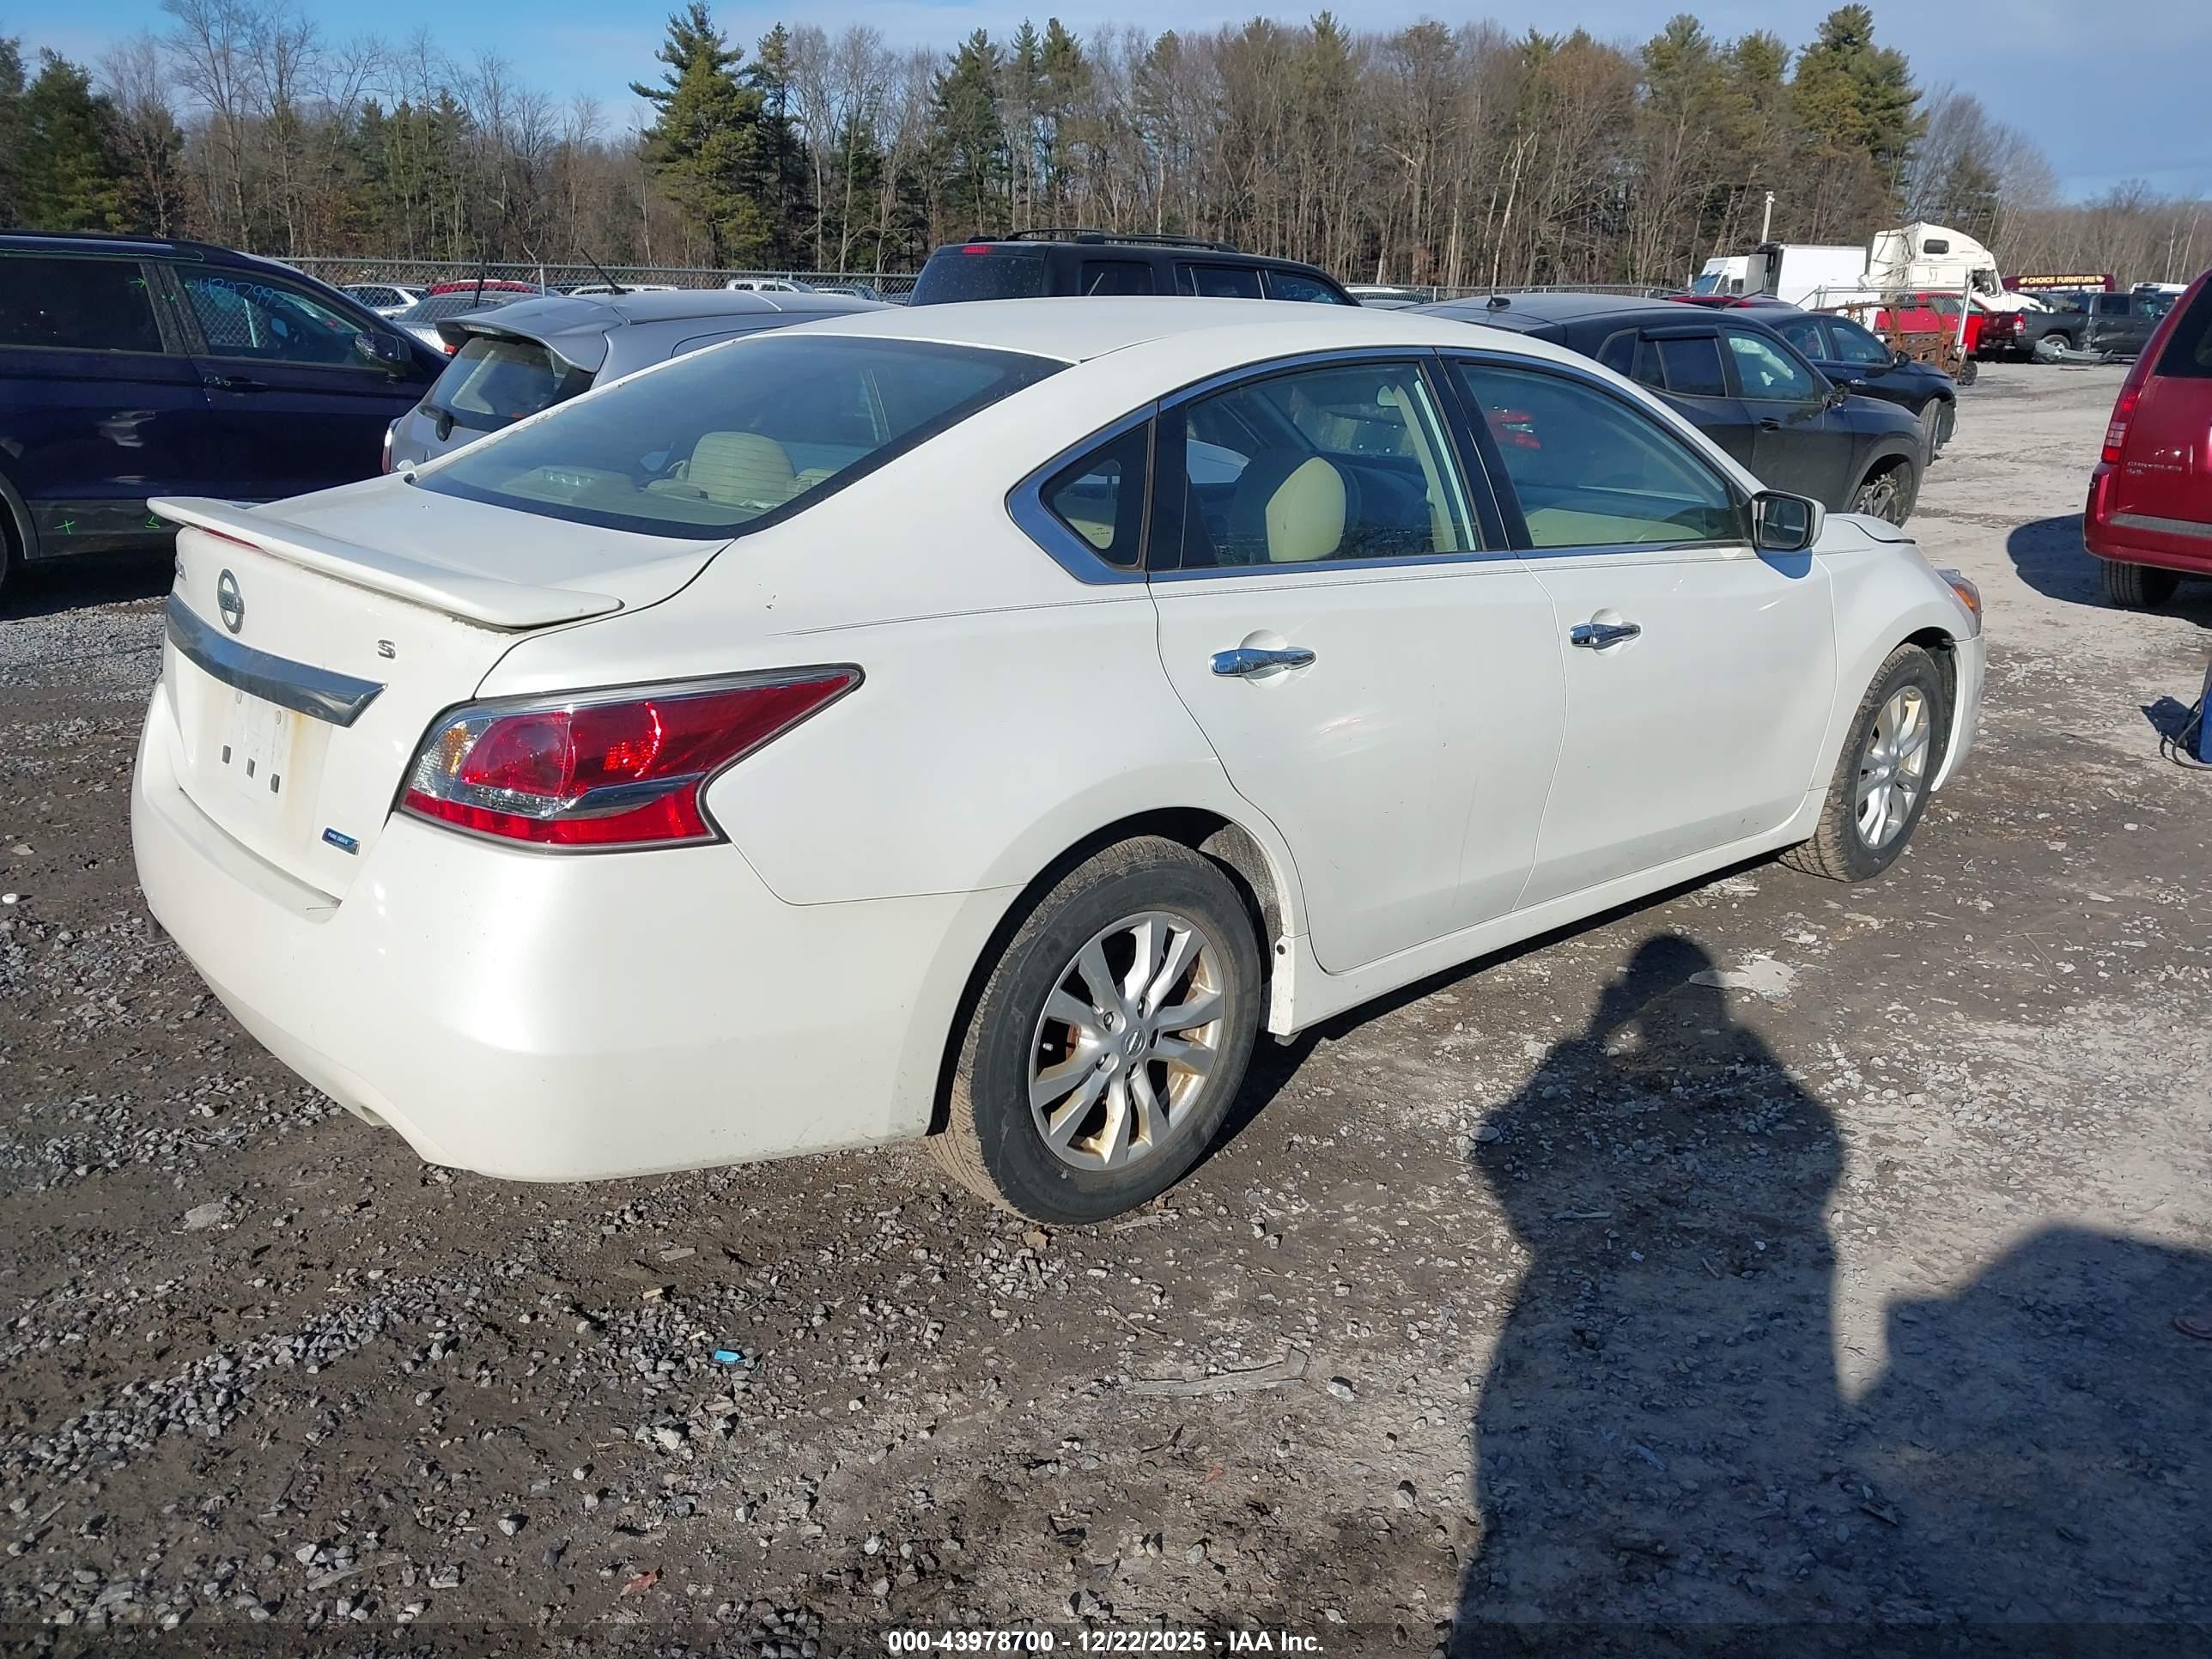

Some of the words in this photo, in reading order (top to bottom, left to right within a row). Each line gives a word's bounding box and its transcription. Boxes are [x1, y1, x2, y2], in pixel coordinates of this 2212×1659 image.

[2027, 276, 2056, 284] CHOICE
[2057, 275, 2096, 284] FURNITURE
[377, 639, 396, 659] S
